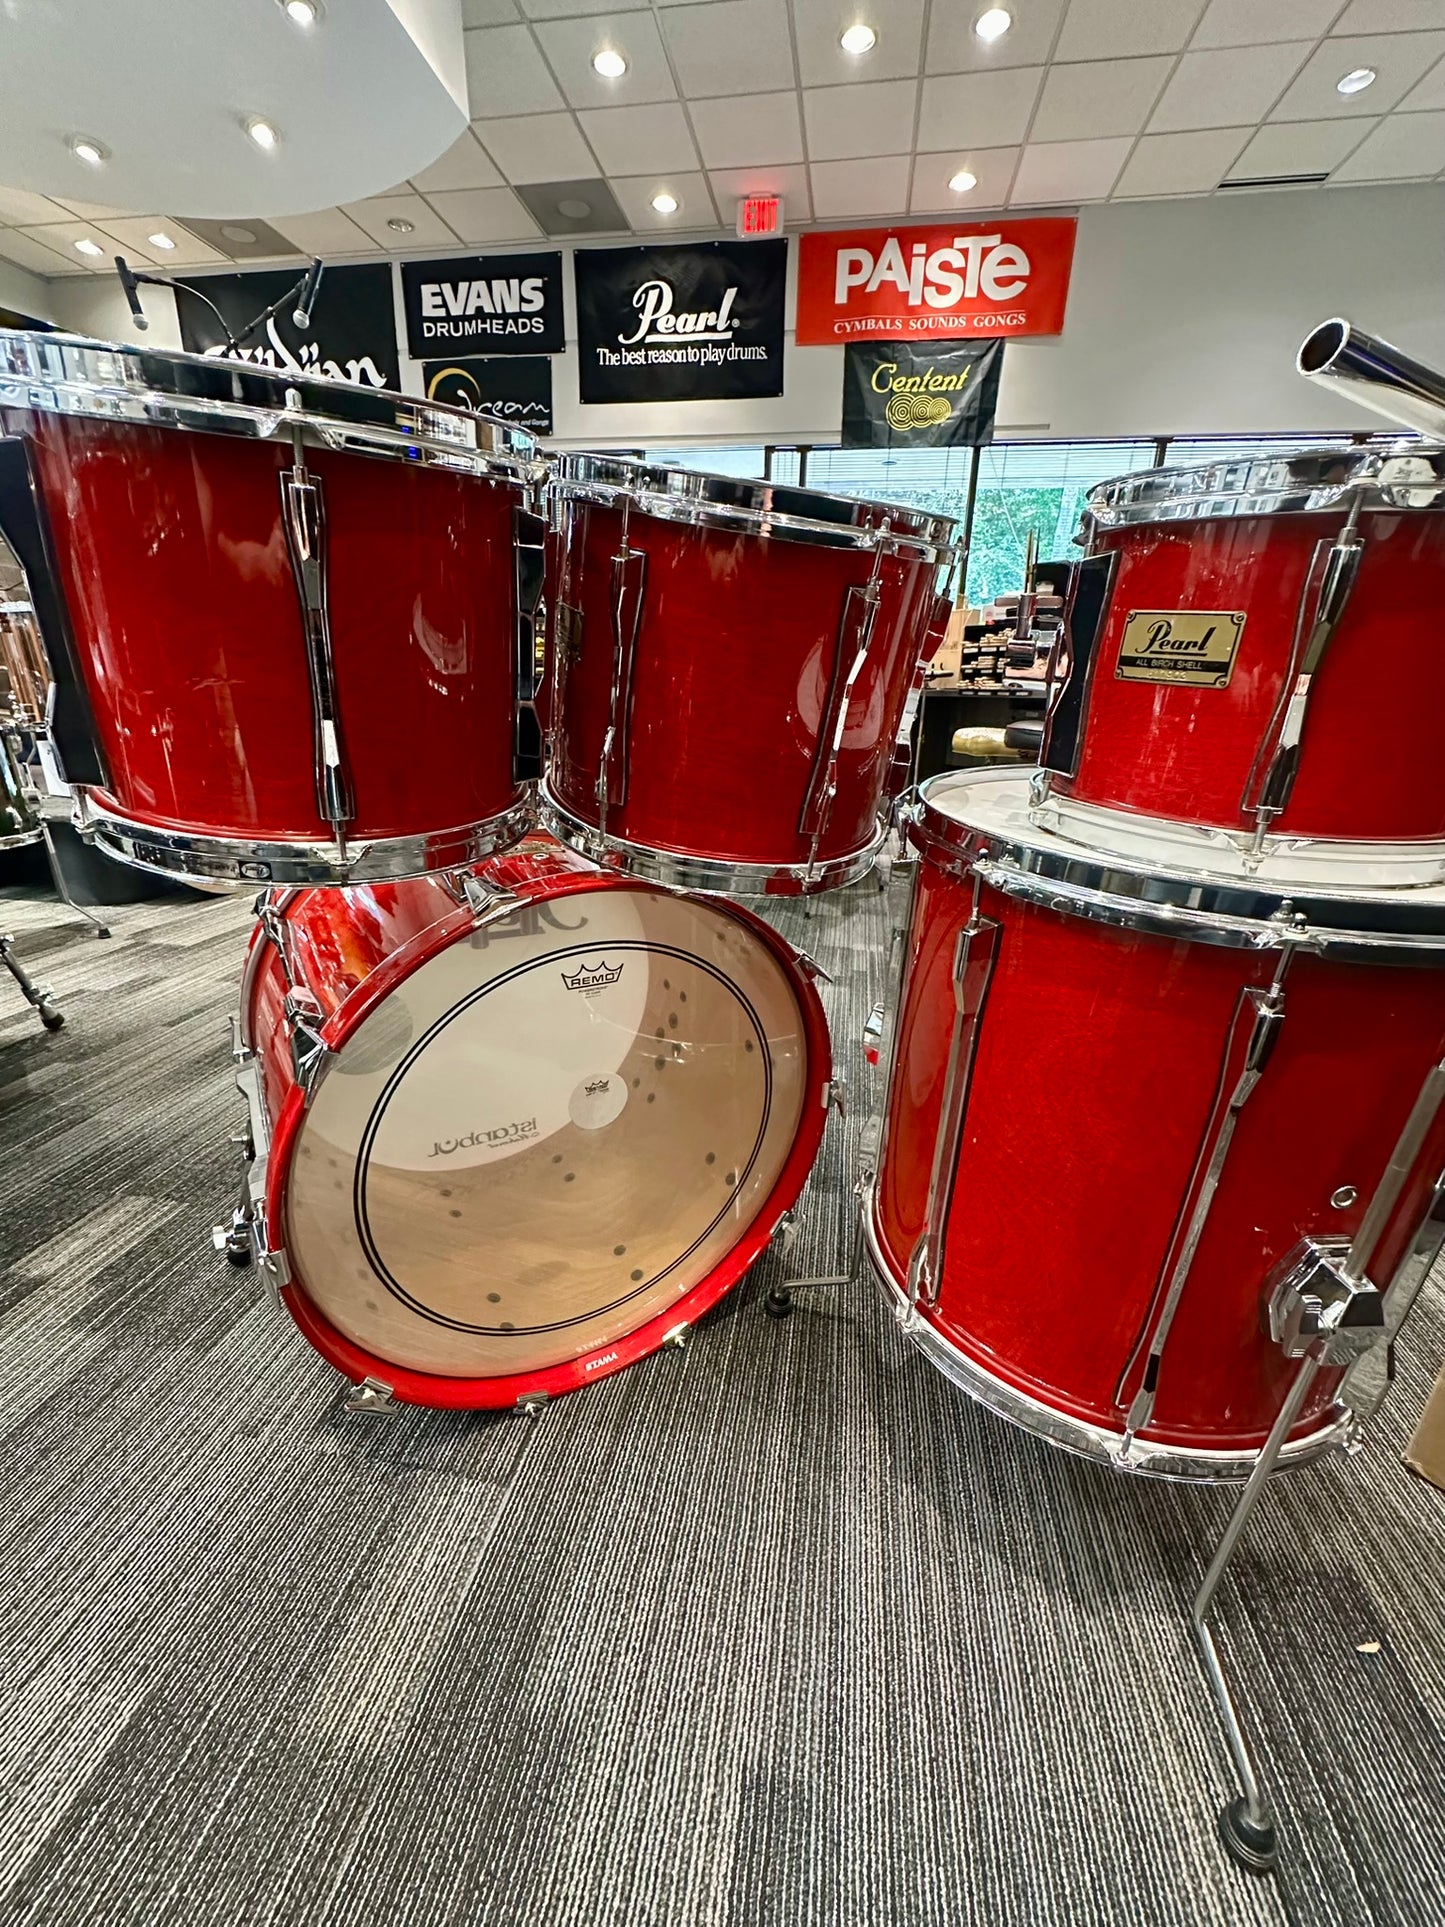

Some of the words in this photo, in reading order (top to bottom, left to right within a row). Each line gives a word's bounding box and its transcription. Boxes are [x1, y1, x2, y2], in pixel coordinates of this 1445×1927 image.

[744, 199, 779, 233] EXIT
[421, 278, 545, 317] EVANS
[617, 280, 738, 344] Pearl
[834, 318, 903, 333] CYMBALS
[909, 316, 967, 331] SOUNDS
[973, 313, 1026, 327] GONGS
[423, 317, 545, 337] DRUMHEADS
[597, 348, 621, 366] The
[621, 348, 647, 365] best
[647, 346, 687, 363] reason
[686, 346, 700, 362] to
[700, 343, 727, 366] play
[727, 342, 768, 361] drums.
[871, 363, 971, 394] Centent
[1135, 619, 1217, 653] Pearl
[1151, 659, 1174, 667] BIRCH
[1176, 661, 1202, 670] SHELL
[571, 973, 615, 987] REMO
[590, 1351, 618, 1368] TAMA
